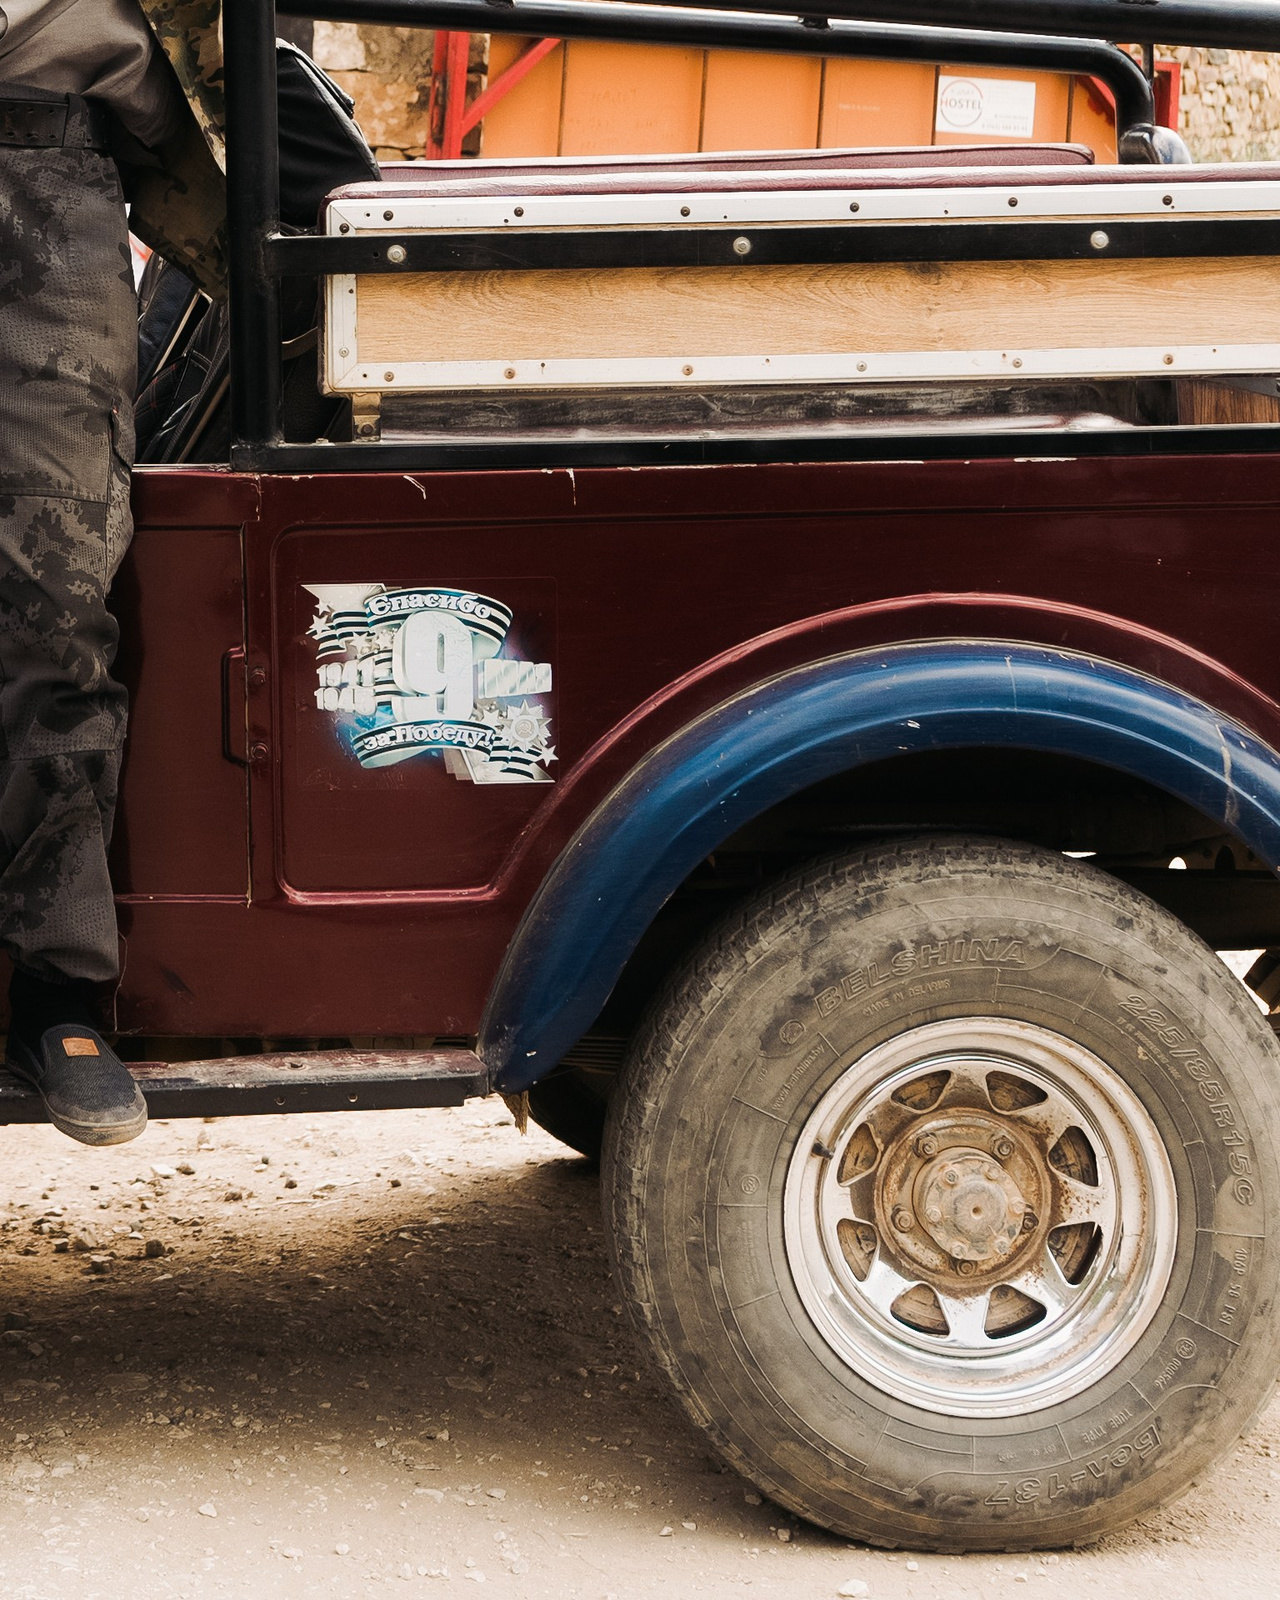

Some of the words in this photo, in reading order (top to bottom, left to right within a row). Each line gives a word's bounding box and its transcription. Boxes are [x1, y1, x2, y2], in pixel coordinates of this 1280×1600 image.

[940, 97, 982, 110] HOSTEL
[368, 593, 493, 619] Спасибо
[316, 658, 376, 688] 1941
[392, 610, 474, 721] 9
[363, 730, 392, 750] за
[813, 938, 1026, 1018] BELSHINA
[1118, 994, 1255, 1206] 225/85R15C
[984, 1424, 1163, 1506] Бел-137
